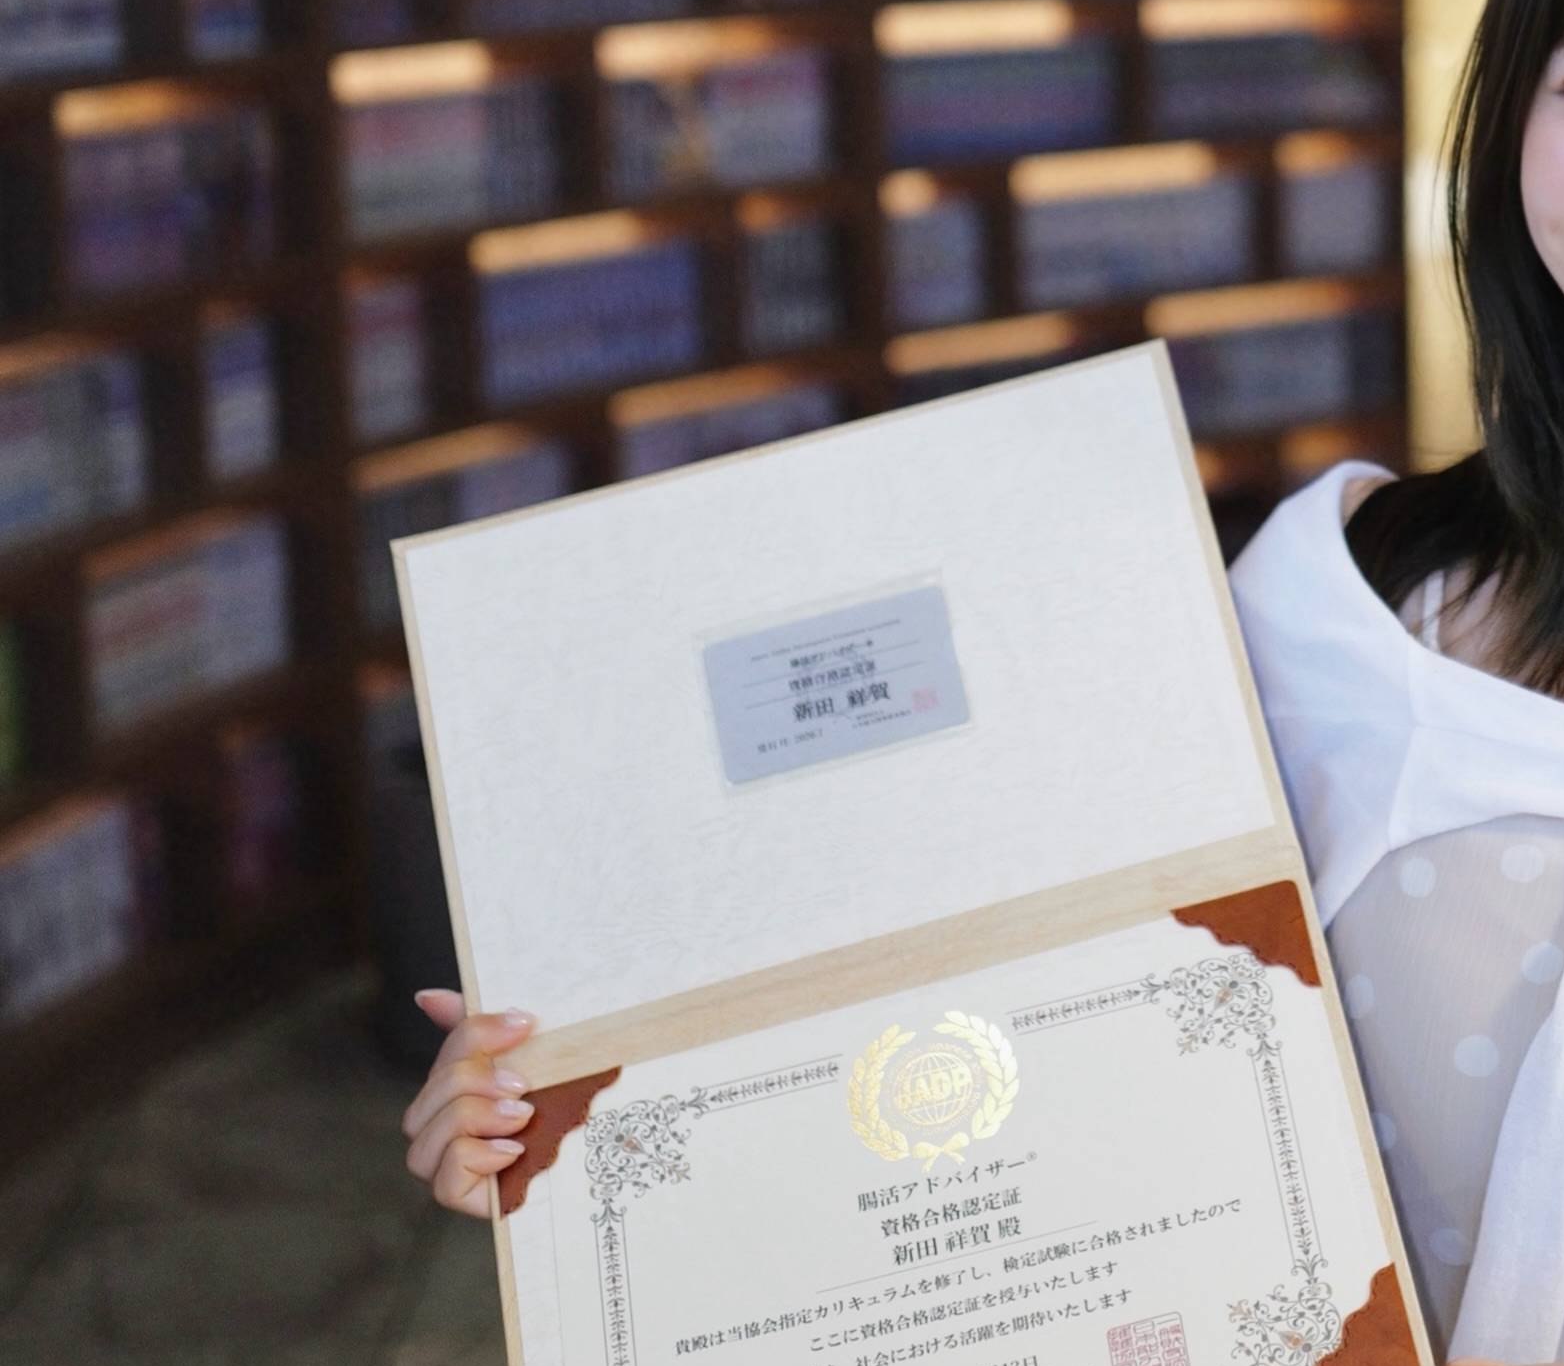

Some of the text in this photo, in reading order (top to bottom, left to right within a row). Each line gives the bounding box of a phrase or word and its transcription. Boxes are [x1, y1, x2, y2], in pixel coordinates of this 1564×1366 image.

[881, 1187, 1022, 1238] 資格合格認定証
[893, 1216, 1021, 1266] 新田 祥賀 殿
[809, 1260, 1118, 1353] ここに資格合格認定証を授与いたします
